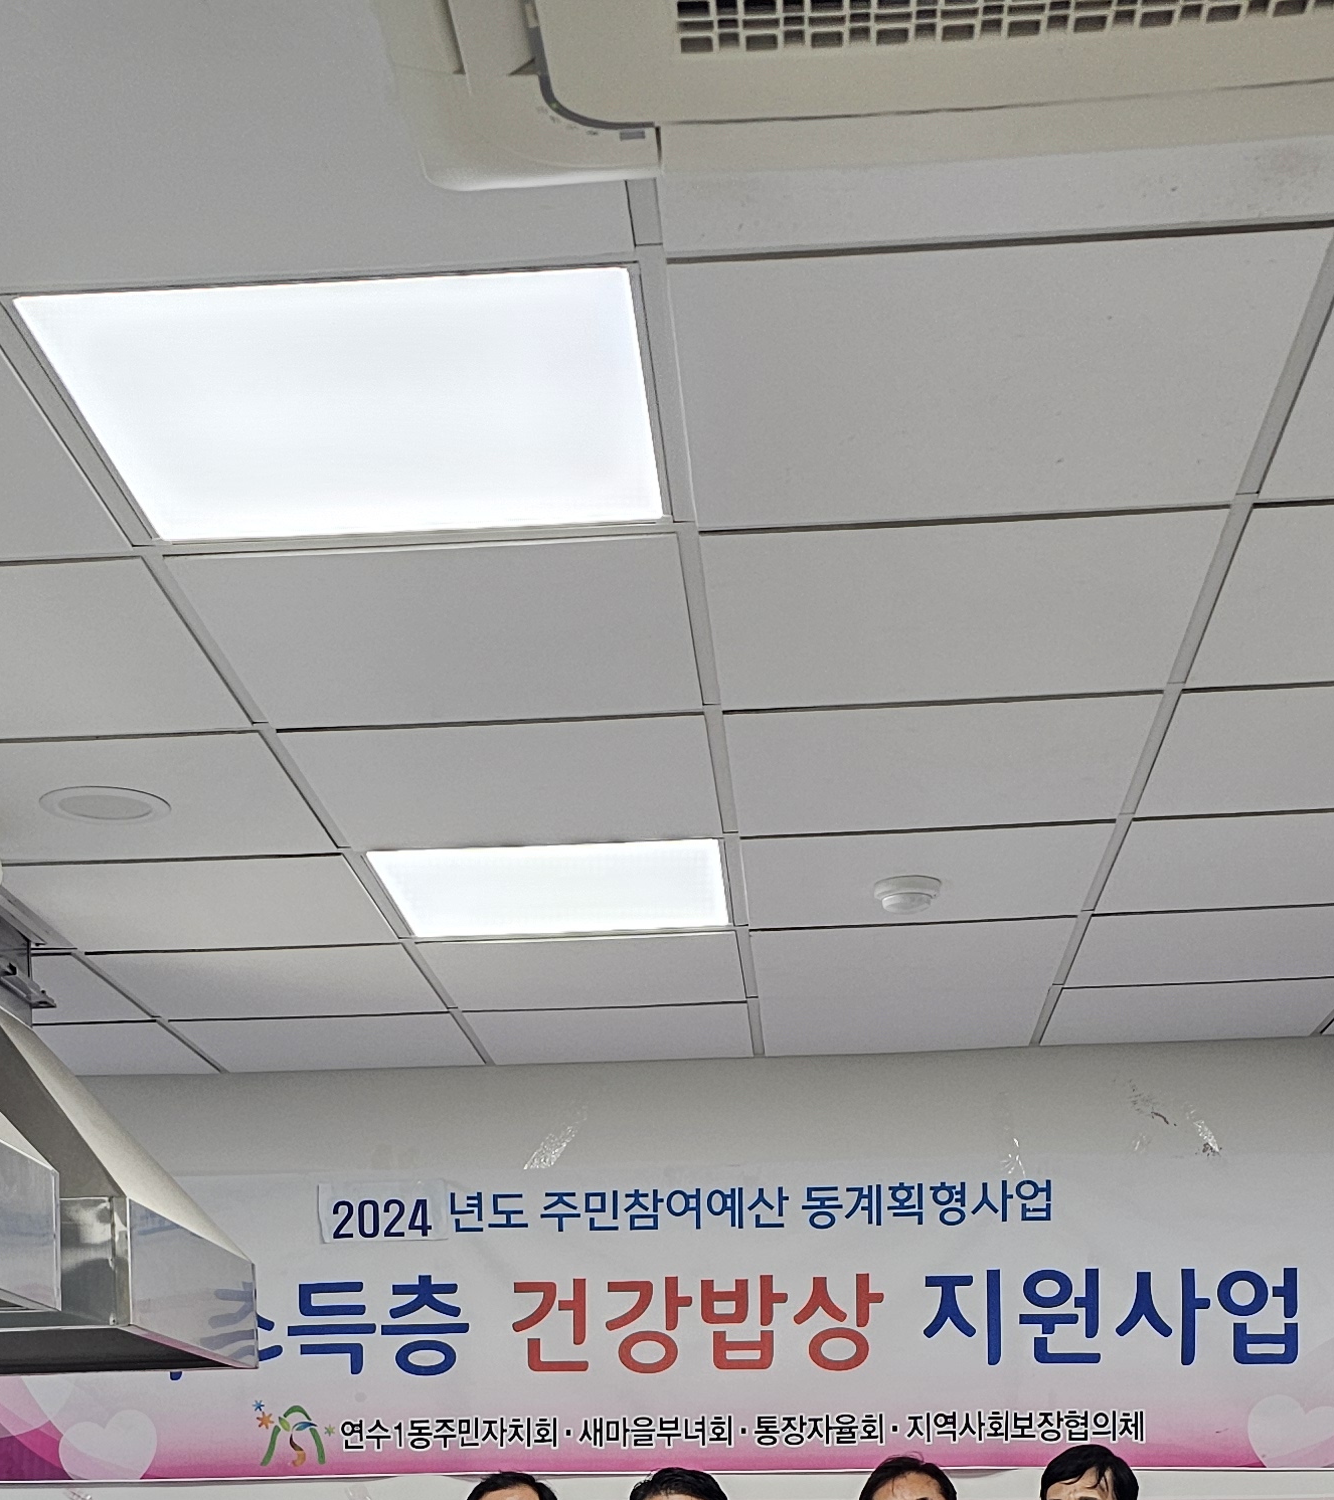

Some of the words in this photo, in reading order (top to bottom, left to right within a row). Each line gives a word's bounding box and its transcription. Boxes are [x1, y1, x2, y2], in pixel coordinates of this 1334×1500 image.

[332, 1198, 433, 1239] 2024
[449, 1190, 529, 1233] 년도
[540, 1186, 789, 1232] 주민참여예산
[801, 1178, 1052, 1230] 동계획형사업
[257, 1274, 470, 1376] 득층
[511, 1272, 886, 1373] 건강밥상
[922, 1266, 1300, 1367] 지원사업
[340, 1416, 558, 1450] 연수1동주민자치회
[579, 1414, 734, 1448] 새마을부녀회
[753, 1413, 885, 1446] 통장자율회
[907, 1410, 1147, 1443] 지역사회보장협의체
